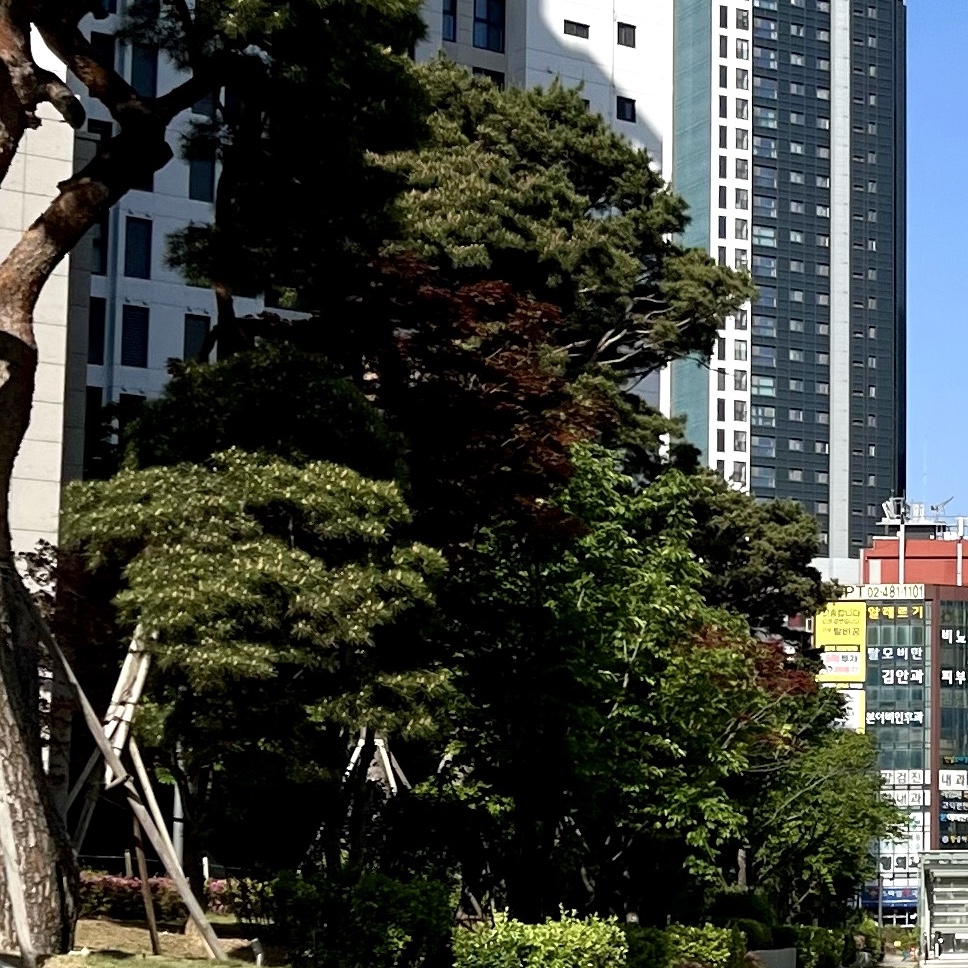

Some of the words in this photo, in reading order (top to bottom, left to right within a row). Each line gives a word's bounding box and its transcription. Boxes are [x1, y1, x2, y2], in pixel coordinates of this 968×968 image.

[867, 606, 924, 619] 알레르기
[881, 669, 924, 684] 김안과
[942, 773, 965, 787] 내과
